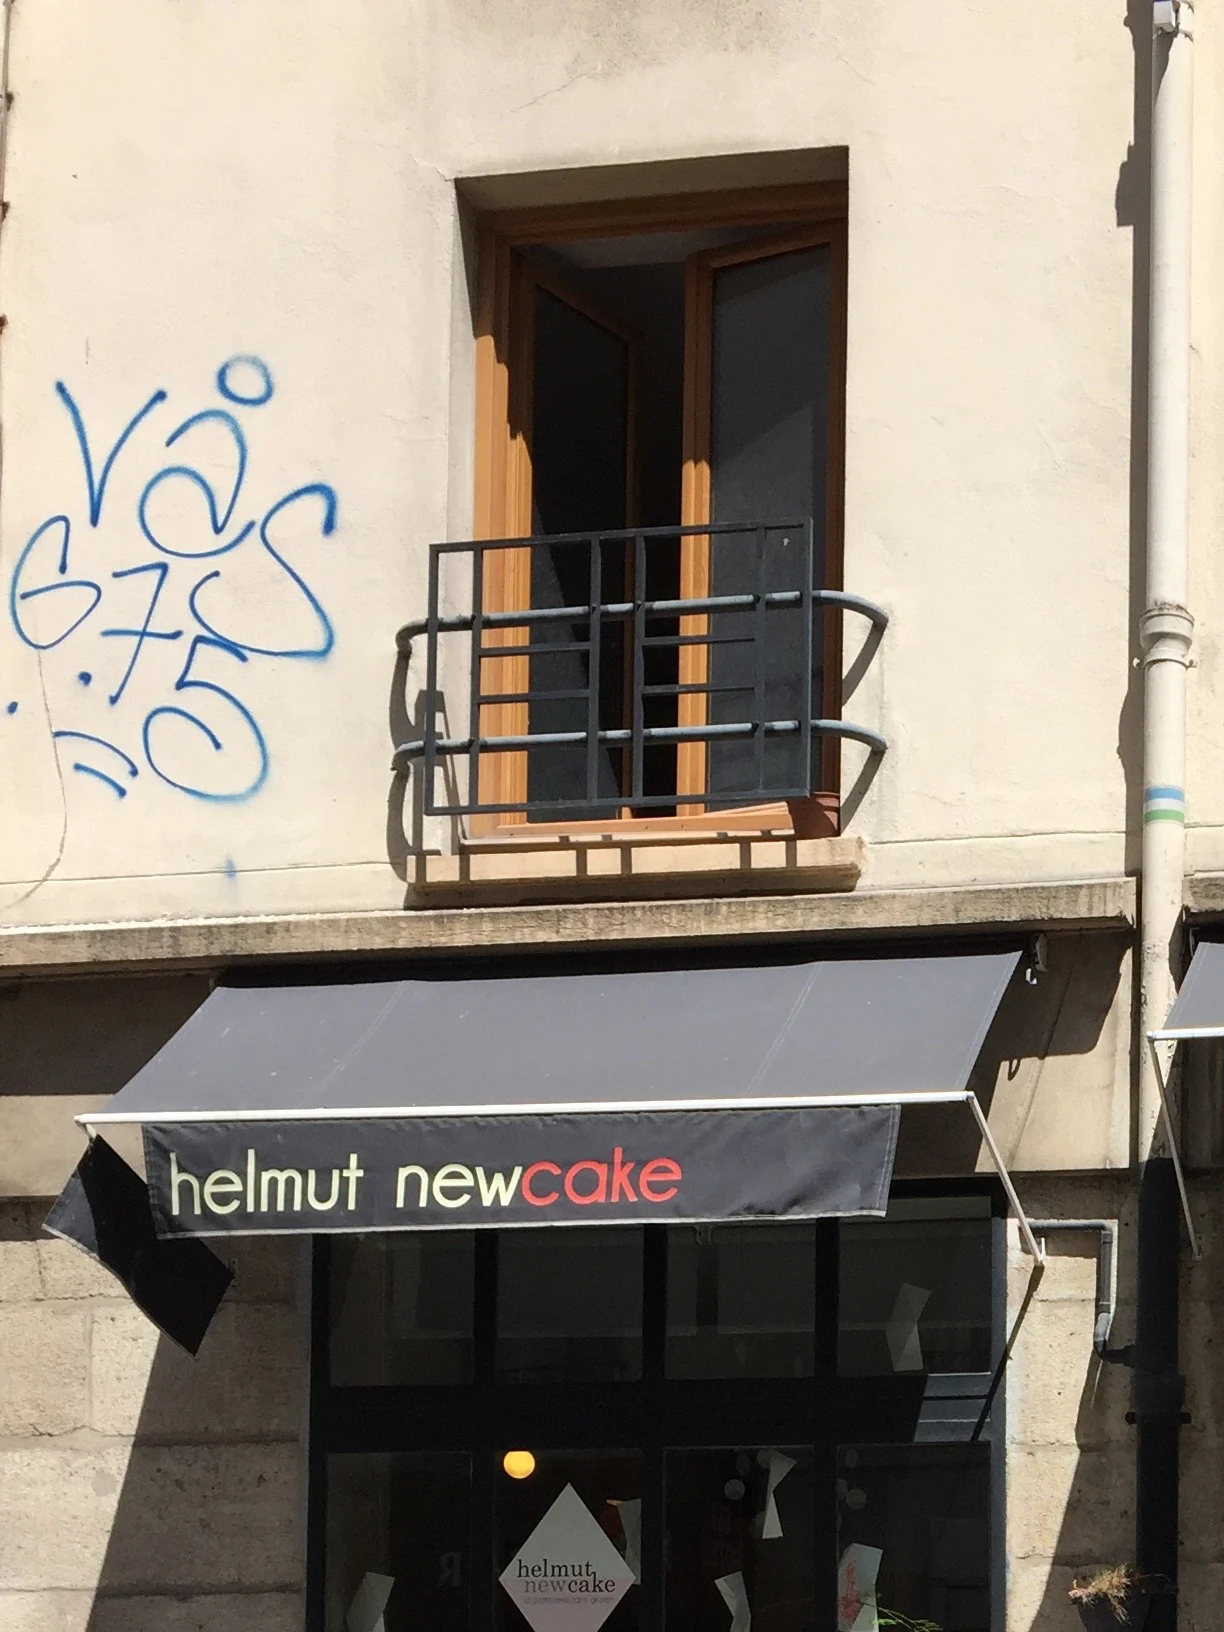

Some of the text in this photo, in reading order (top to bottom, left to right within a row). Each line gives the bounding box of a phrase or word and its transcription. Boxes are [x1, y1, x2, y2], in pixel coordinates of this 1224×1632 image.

[169, 1146, 683, 1216] helmut newcake
[517, 1559, 616, 1593] helmut newcake
